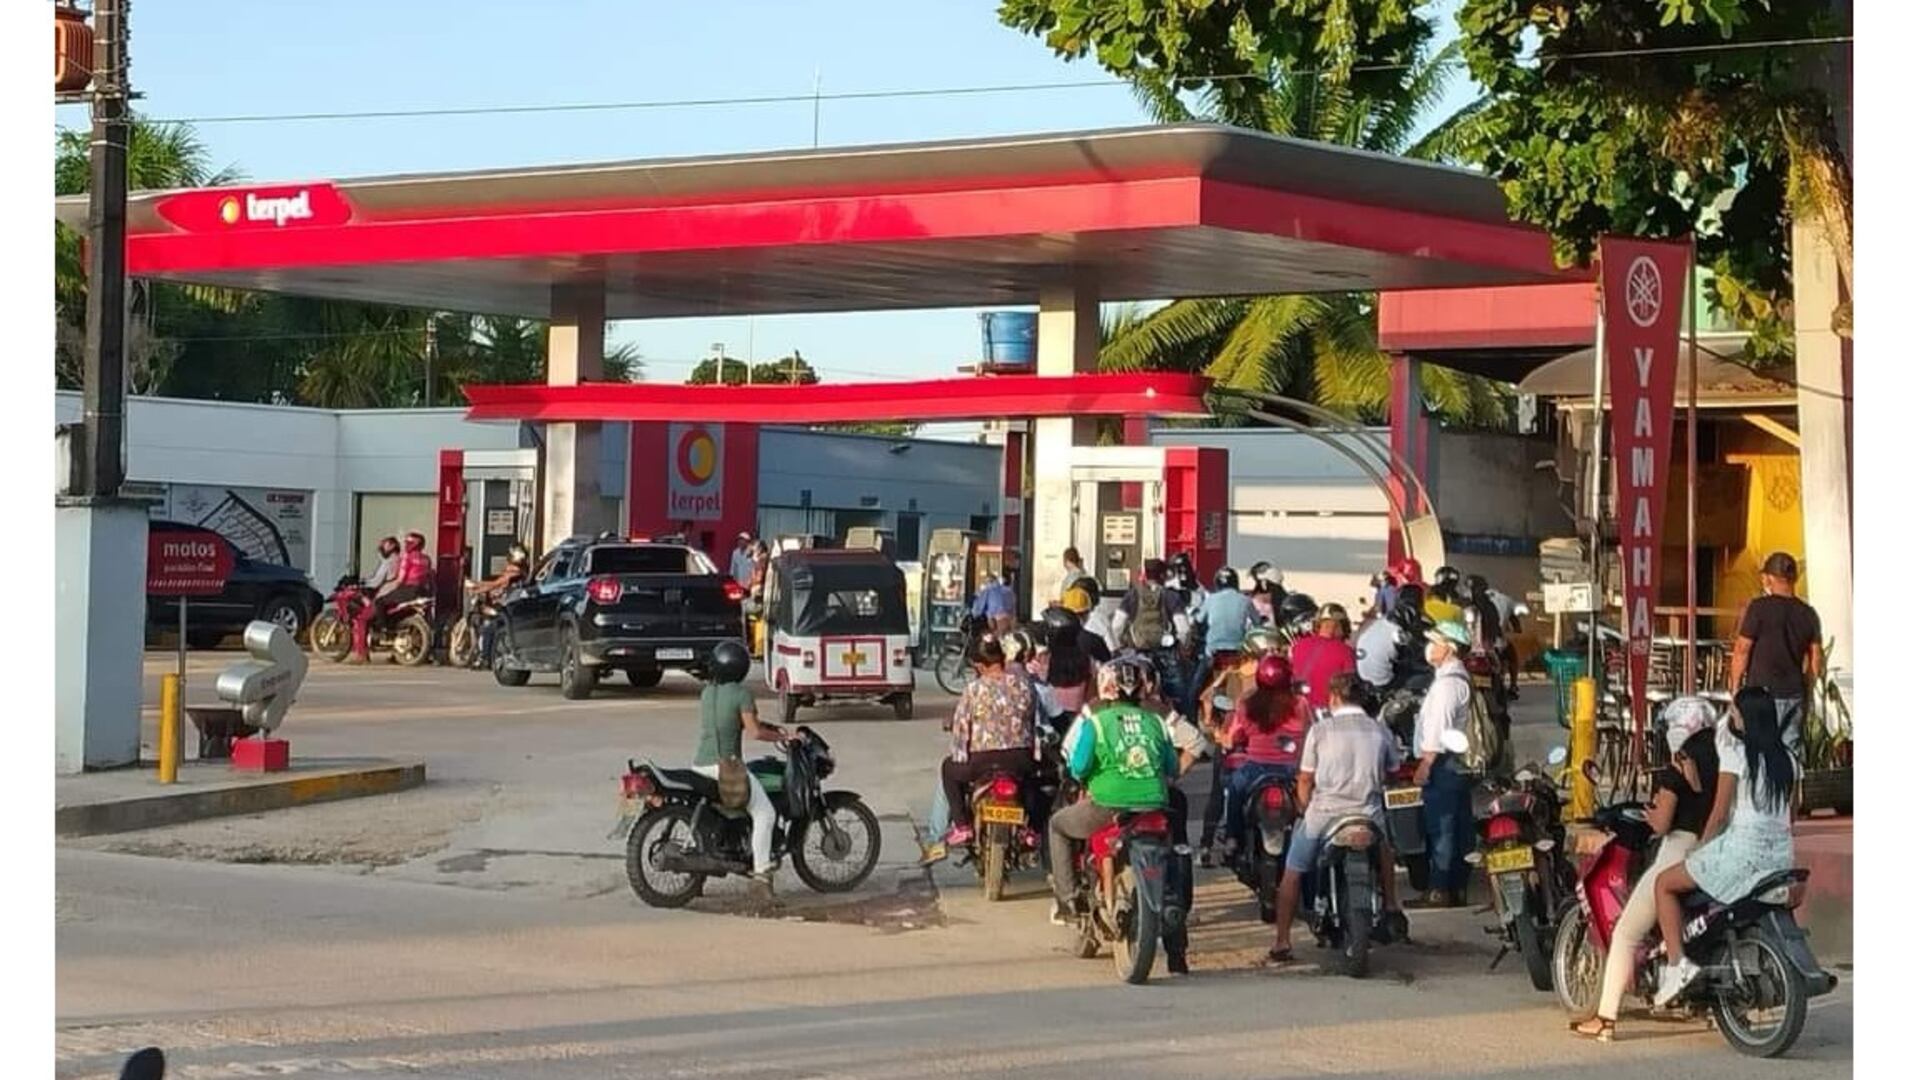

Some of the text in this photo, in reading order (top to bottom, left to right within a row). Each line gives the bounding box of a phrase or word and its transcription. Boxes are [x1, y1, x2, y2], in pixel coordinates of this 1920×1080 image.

[246, 190, 313, 227] terpel
[671, 488, 720, 513] terpel
[1631, 347, 1654, 637] YAMAHA
[163, 541, 216, 557] motos
